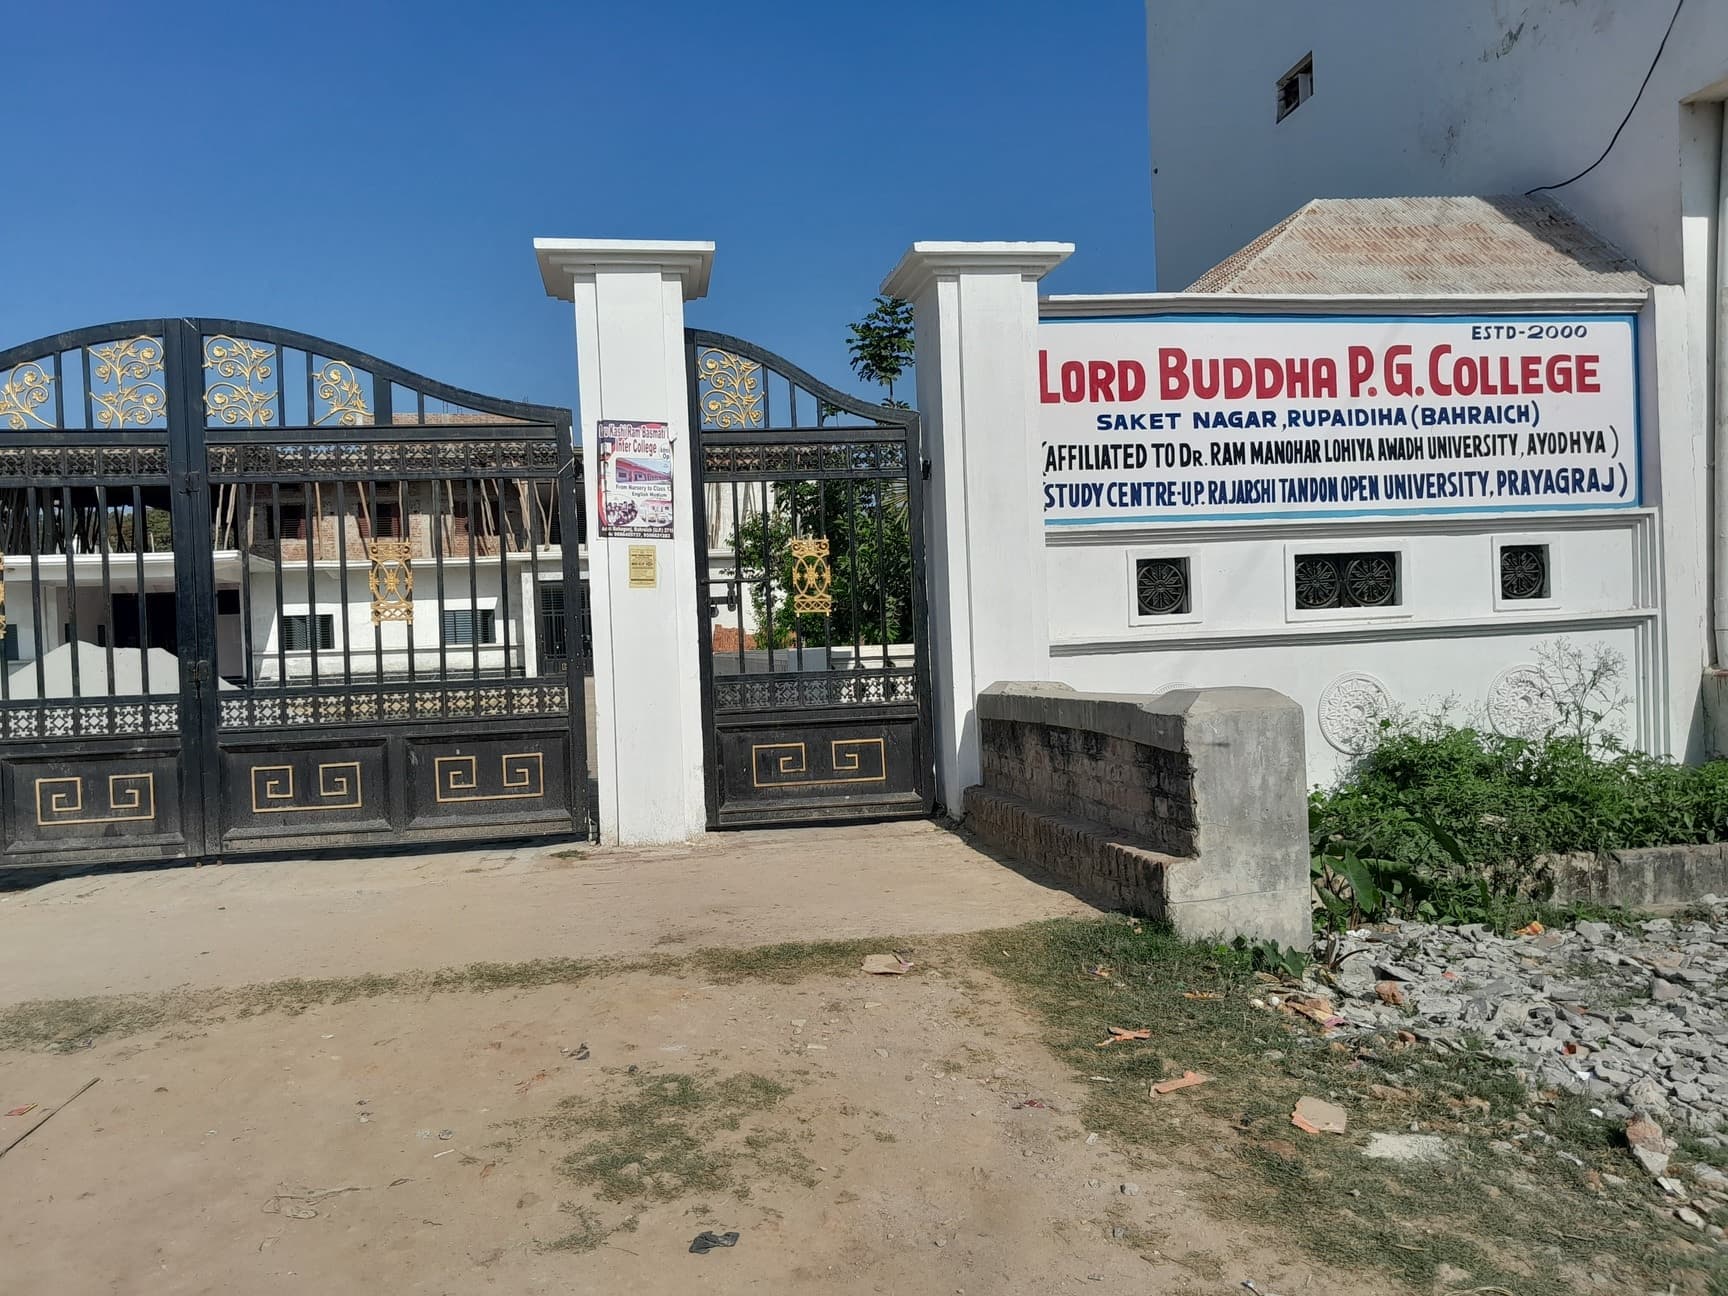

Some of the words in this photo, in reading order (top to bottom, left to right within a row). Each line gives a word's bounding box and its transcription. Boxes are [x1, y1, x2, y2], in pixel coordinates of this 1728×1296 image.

[1471, 325, 1588, 341] ESTD-2000
[1039, 350, 1145, 403] LORD
[1159, 348, 1337, 400] BUDDHA
[1097, 413, 1181, 430] SAKET
[616, 439, 631, 453] Inter
[633, 440, 657, 456] College
[1151, 443, 1175, 468] TO
[1211, 442, 1245, 466] RAM
[1250, 440, 1321, 464] MANOHAR
[1325, 438, 1375, 462] LOHIYA
[1378, 437, 1424, 461] AWADH
[1428, 433, 1523, 459] UNIVERSITY,
[1043, 482, 1104, 512] STUDY
[1208, 479, 1275, 504] RAJARSHI
[1279, 477, 1338, 503] TANDON
[1341, 475, 1379, 501] OPEN
[1384, 471, 1493, 499] UNIVERSITY,
[1497, 463, 1627, 497] PRAYAGRAJ)
